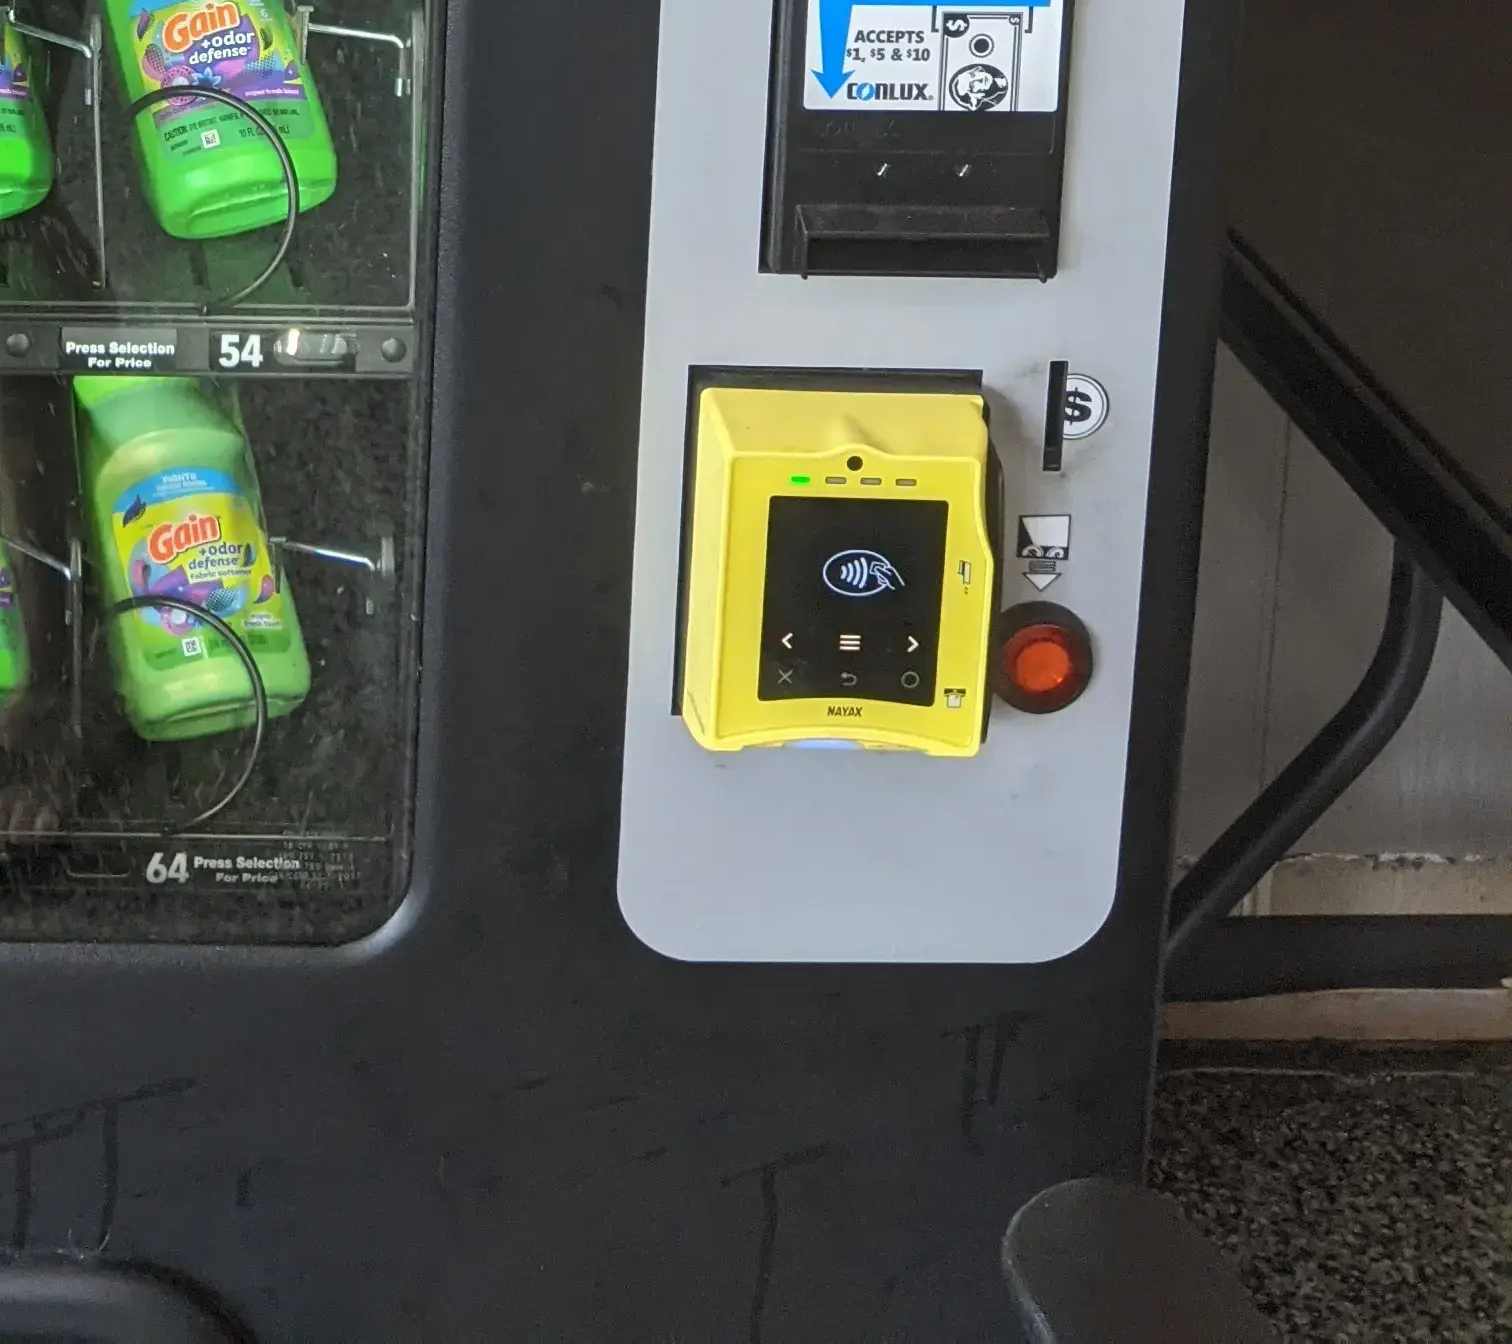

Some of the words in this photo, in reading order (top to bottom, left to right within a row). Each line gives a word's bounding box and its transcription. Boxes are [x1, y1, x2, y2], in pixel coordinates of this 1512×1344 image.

[162, 2, 240, 53] Gain
[854, 29, 925, 44] ACCEPTS
[846, 48, 866, 63] $1,
[870, 48, 886, 62] $5
[890, 48, 903, 62] &
[906, 48, 931, 62] $10
[846, 83, 929, 101] CONLUX
[65, 342, 106, 357] Press
[109, 342, 175, 356] Selection
[219, 335, 262, 367] 54
[88, 357, 113, 369] For
[116, 357, 152, 369] Price
[147, 514, 221, 564] Gain
[827, 705, 863, 717] NAYAX
[146, 853, 188, 883] 64
